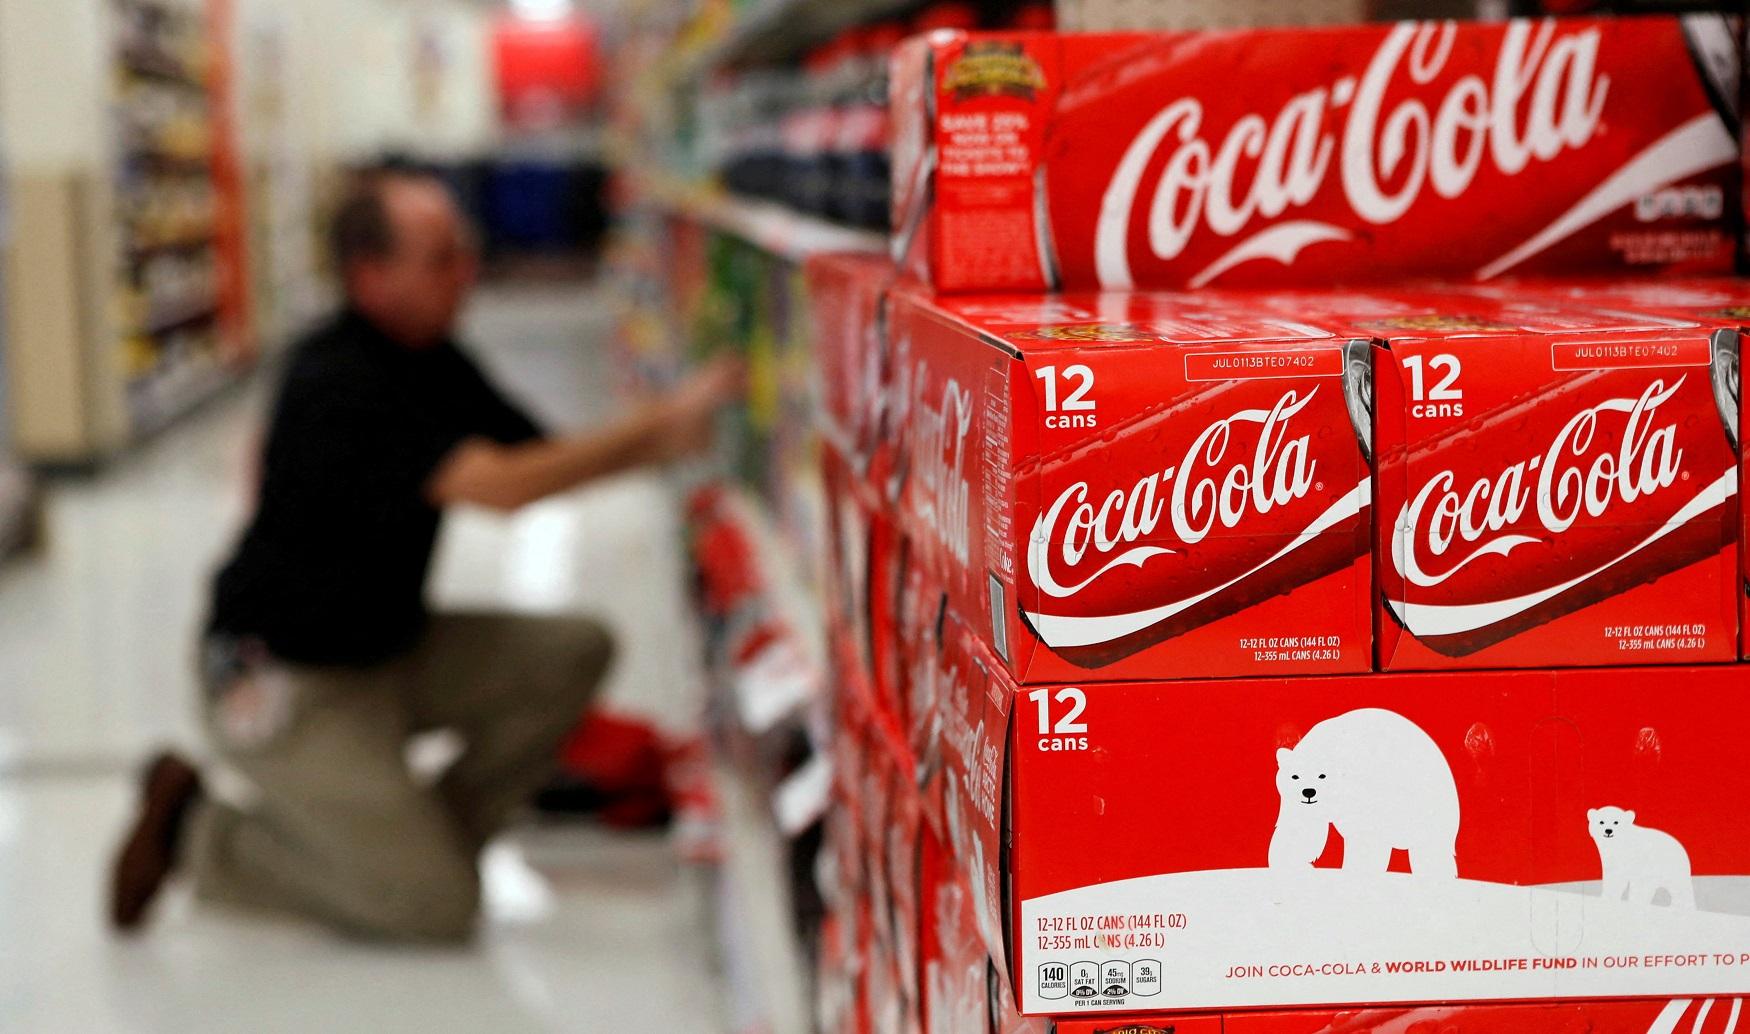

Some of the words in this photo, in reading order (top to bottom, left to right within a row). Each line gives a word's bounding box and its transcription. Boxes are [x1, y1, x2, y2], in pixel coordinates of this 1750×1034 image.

[1095, 20, 1612, 289] Coca-Cola
[1212, 356, 1314, 368] JUL0113BTE07402
[1402, 353, 1463, 401] 12
[1035, 364, 1096, 412] 12
[1412, 402, 1464, 419] cans
[1045, 412, 1097, 429] cans
[1391, 372, 1687, 587] Coca-Cola
[1027, 383, 1320, 597] Coca-Cola
[1605, 627, 1622, 638] 12-12
[1623, 627, 1632, 637] FL
[1633, 626, 1643, 637] OZ
[1644, 626, 1663, 637] CANS
[1665, 625, 1681, 637] (144
[1682, 625, 1690, 636] FL
[1692, 624, 1706, 636] OZ)
[1240, 639, 1257, 649] 12-12
[1259, 638, 1267, 649] FL
[1268, 638, 1278, 648] OZ
[1280, 637, 1299, 648] CANS
[1300, 636, 1316, 649] (144
[1317, 637, 1326, 647] FL
[1327, 636, 1341, 648] OZ)
[1618, 641, 1641, 650] 12-355
[1643, 640, 1655, 650] mL
[1656, 639, 1675, 650] CANS
[1677, 639, 1696, 650] (4.26
[1697, 638, 1706, 649] L)
[1254, 652, 1278, 661] 12-355
[1279, 651, 1290, 661] mL
[1291, 651, 1311, 661] CANS
[1312, 650, 1332, 661] (4.26
[1332, 650, 1341, 660] L)
[1029, 687, 1088, 735] 12
[1038, 735, 1089, 751] cans
[1037, 917, 1063, 932] 12-12
[1066, 917, 1078, 931] FL
[1080, 916, 1094, 931] OZ
[1097, 915, 1125, 930] CANS
[1128, 914, 1151, 931] (144
[1154, 914, 1165, 928] FL
[1168, 913, 1187, 929] OZ)
[1038, 935, 1071, 950] 12-355
[1074, 935, 1090, 949] mL
[1124, 933, 1151, 949] (4.26
[1155, 932, 1165, 948] L)
[1042, 967, 1064, 981] 140
[1225, 965, 1263, 979] JOIN
[1268, 962, 1367, 977] COCA-COLA
[1371, 962, 1381, 974] &
[1386, 960, 1446, 974] WORLD
[1450, 958, 1528, 972] WILDLIFE
[1532, 957, 1577, 970] FUND
[1582, 957, 1598, 969] IN
[1603, 956, 1638, 969] OUR
[1644, 954, 1708, 967] EFFORT
[1713, 953, 1735, 966] TO
[1105, 977, 1127, 985] SODIUM
[1103, 998, 1125, 1006] SERVING
